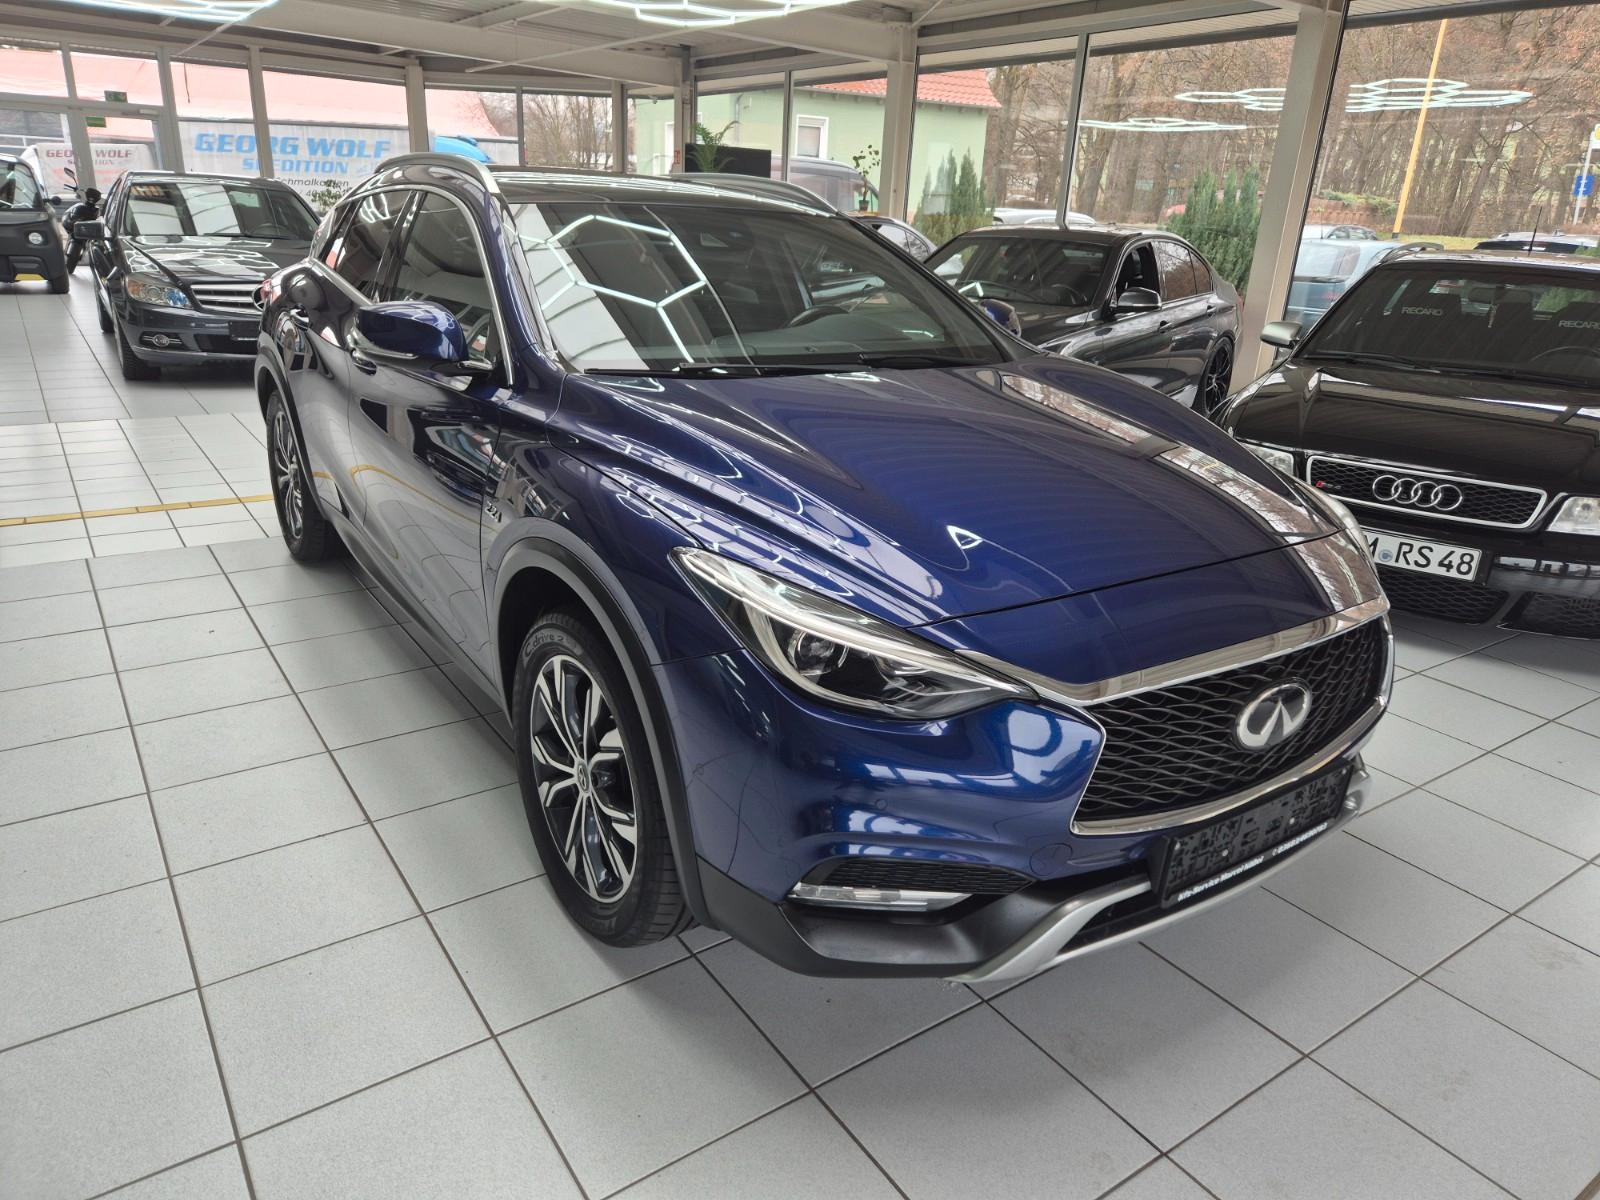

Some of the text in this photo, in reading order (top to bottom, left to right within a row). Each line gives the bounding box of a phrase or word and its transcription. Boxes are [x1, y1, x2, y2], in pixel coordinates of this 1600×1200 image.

[306, 137, 391, 158] WOLF
[95, 149, 133, 158] WOLF
[242, 158, 348, 174] SEDITION
[1401, 306, 1443, 316] RECARO
[1558, 320, 1600, 329] RECAR
